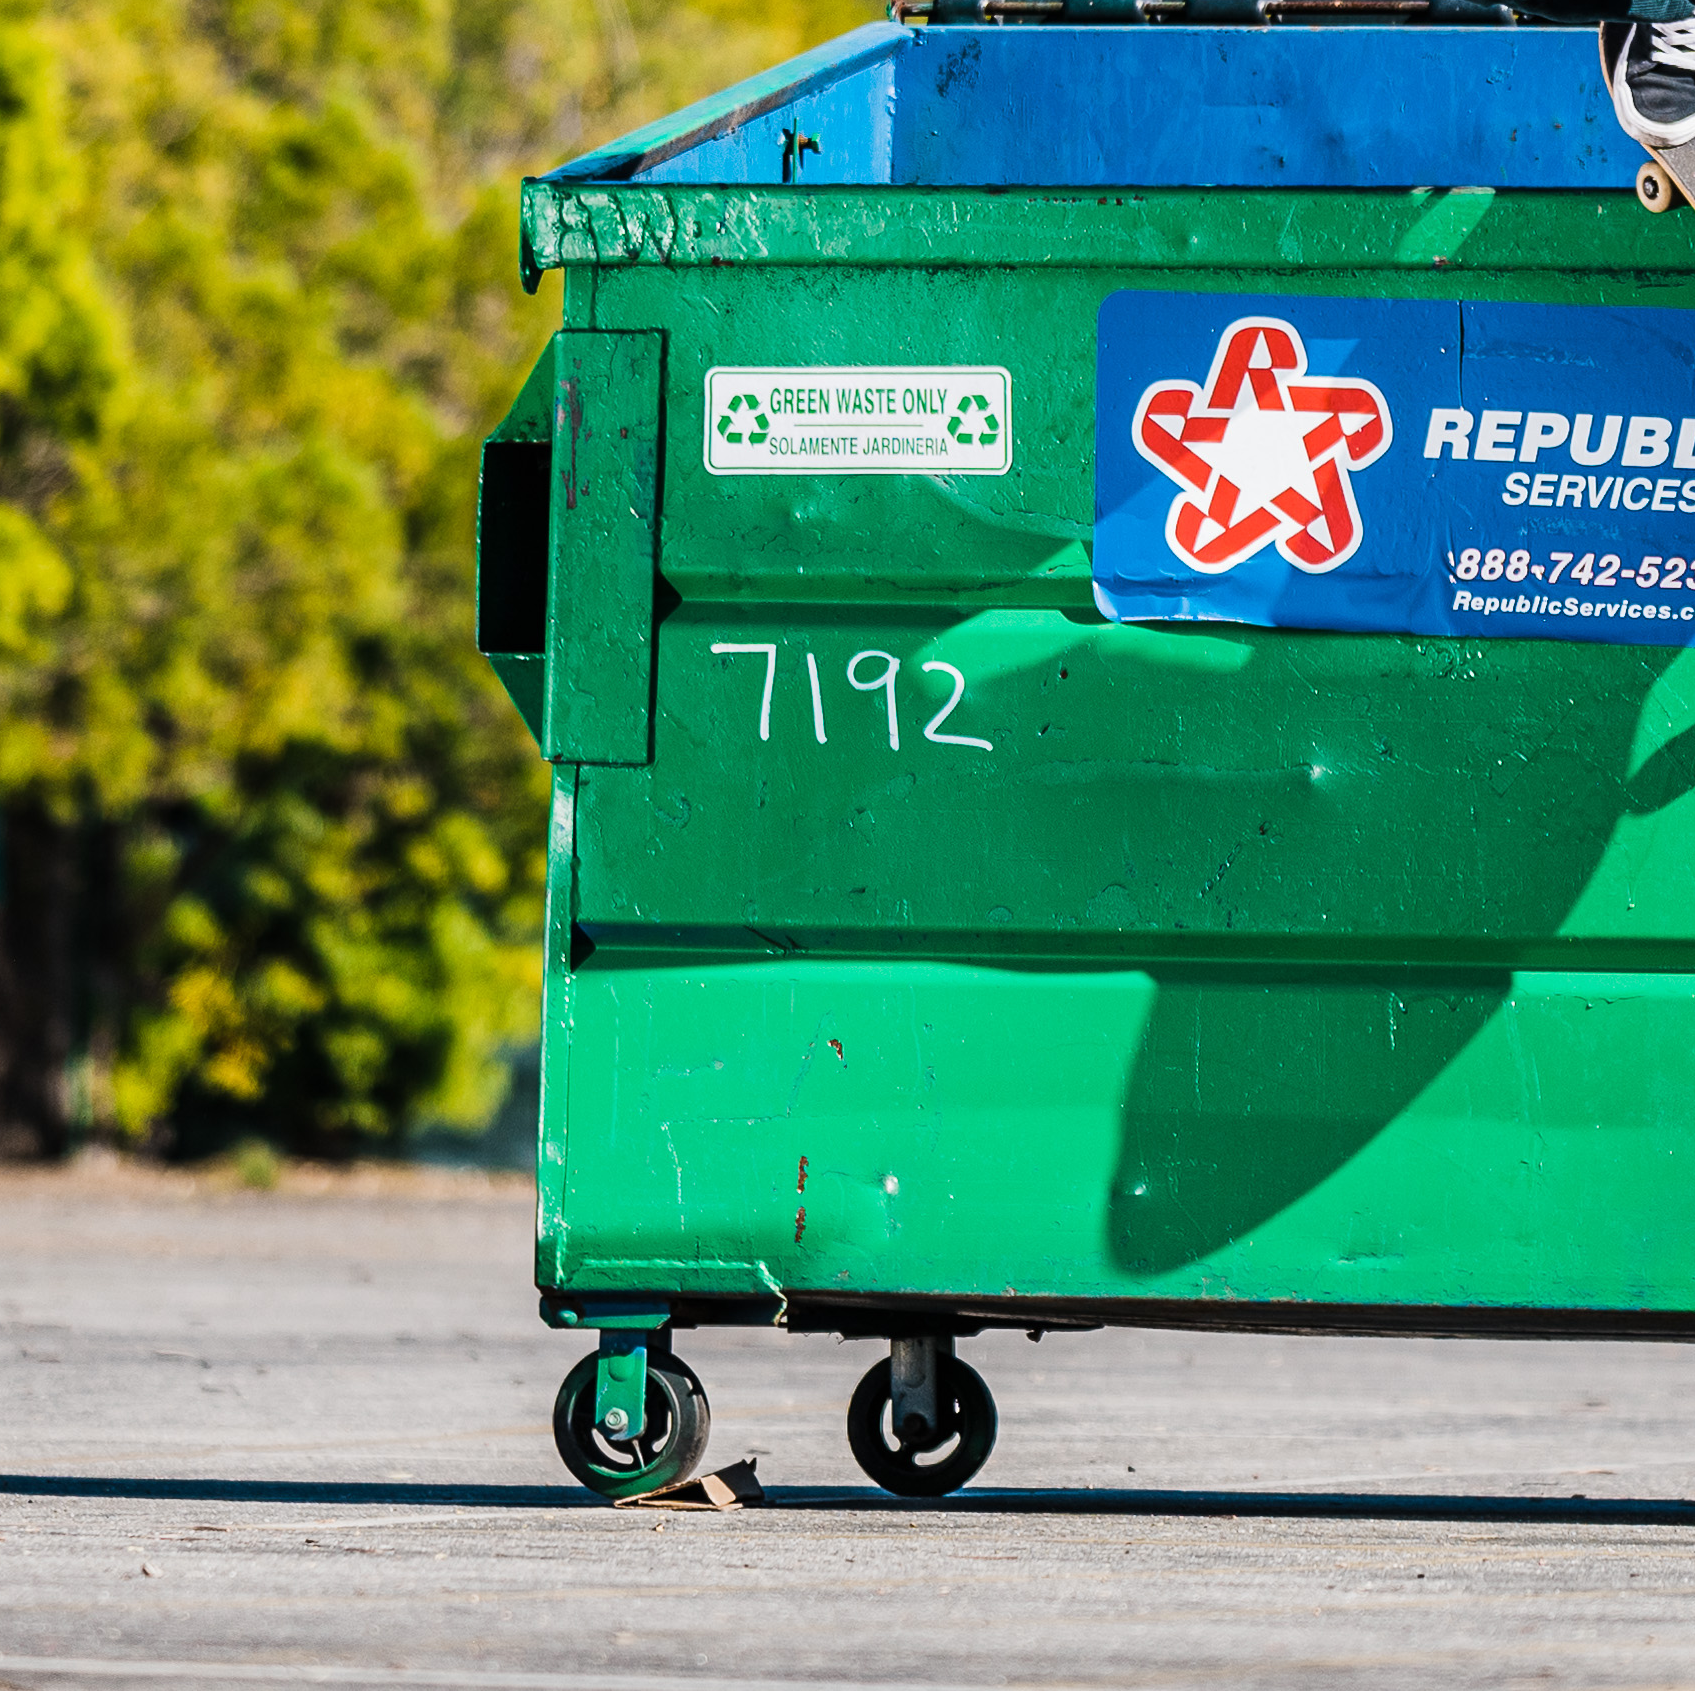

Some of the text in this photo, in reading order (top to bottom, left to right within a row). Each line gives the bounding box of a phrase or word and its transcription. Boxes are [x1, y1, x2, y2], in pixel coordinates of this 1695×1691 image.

[769, 387, 948, 415] GREEN WASTE ONLY
[768, 436, 949, 456] SOLAMENTE JARDINERIA
[710, 642, 994, 752] 7192
